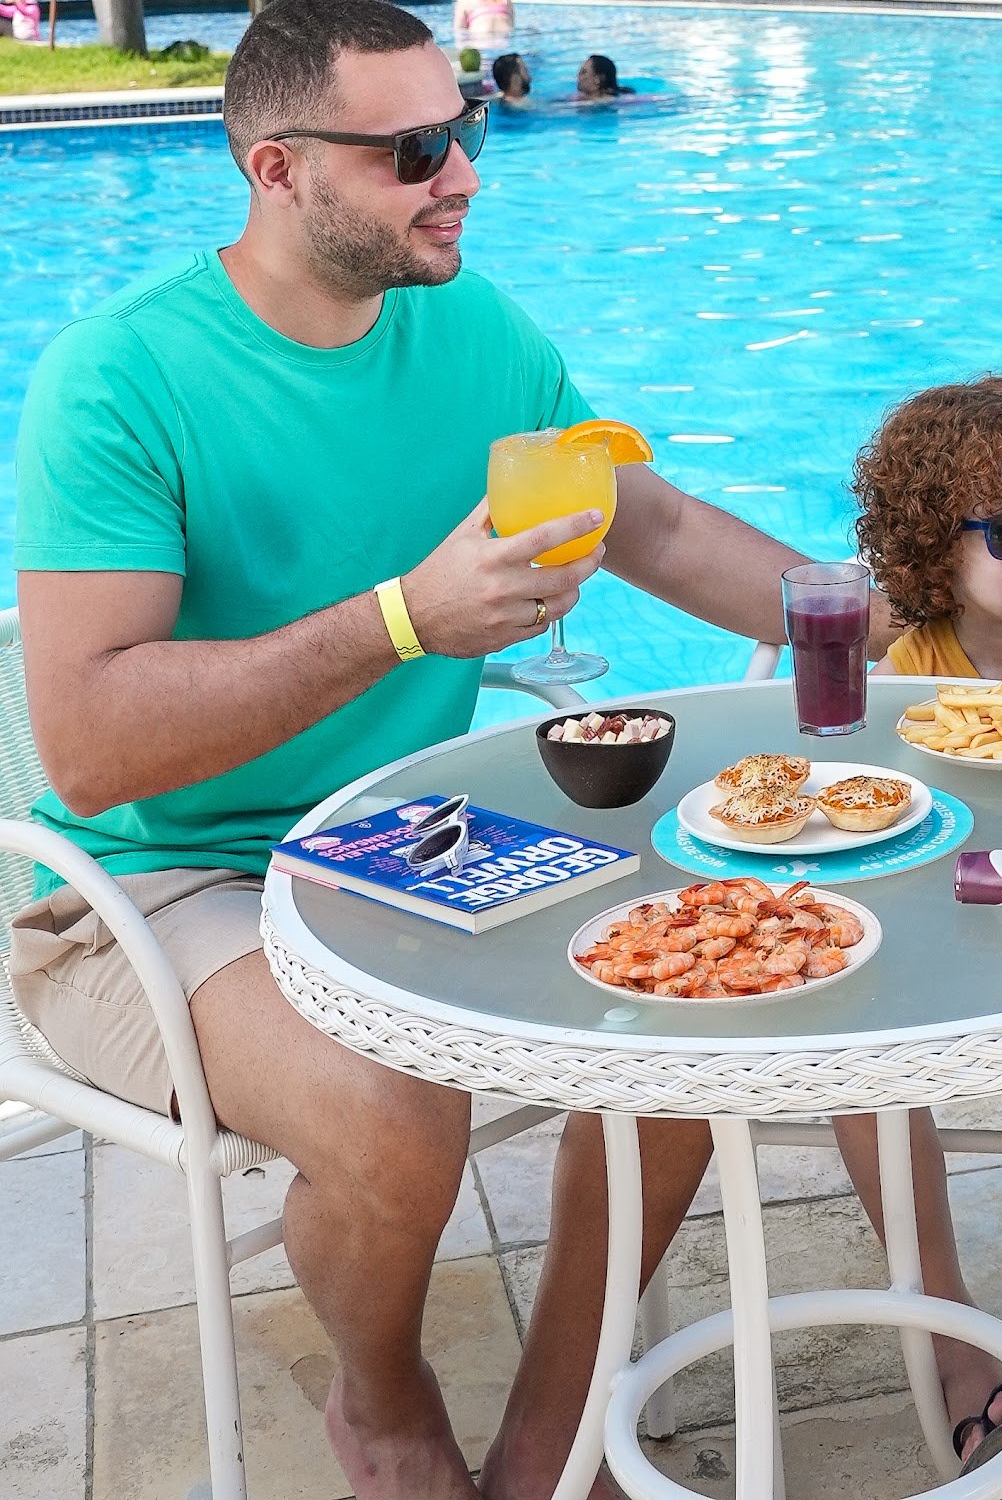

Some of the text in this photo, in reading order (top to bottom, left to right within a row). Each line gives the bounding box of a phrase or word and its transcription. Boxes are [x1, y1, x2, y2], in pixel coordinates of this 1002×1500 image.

[318, 833, 390, 857] ENSAIOS
[329, 841, 393, 861] BALEIA
[859, 862, 884, 872] AS
[885, 843, 937, 866] MESAS
[931, 829, 953, 845] COM
[862, 848, 898, 862] NÃO
[405, 836, 584, 894] ORWELL
[694, 854, 728, 868] SOM
[447, 847, 620, 907] GEORGE
